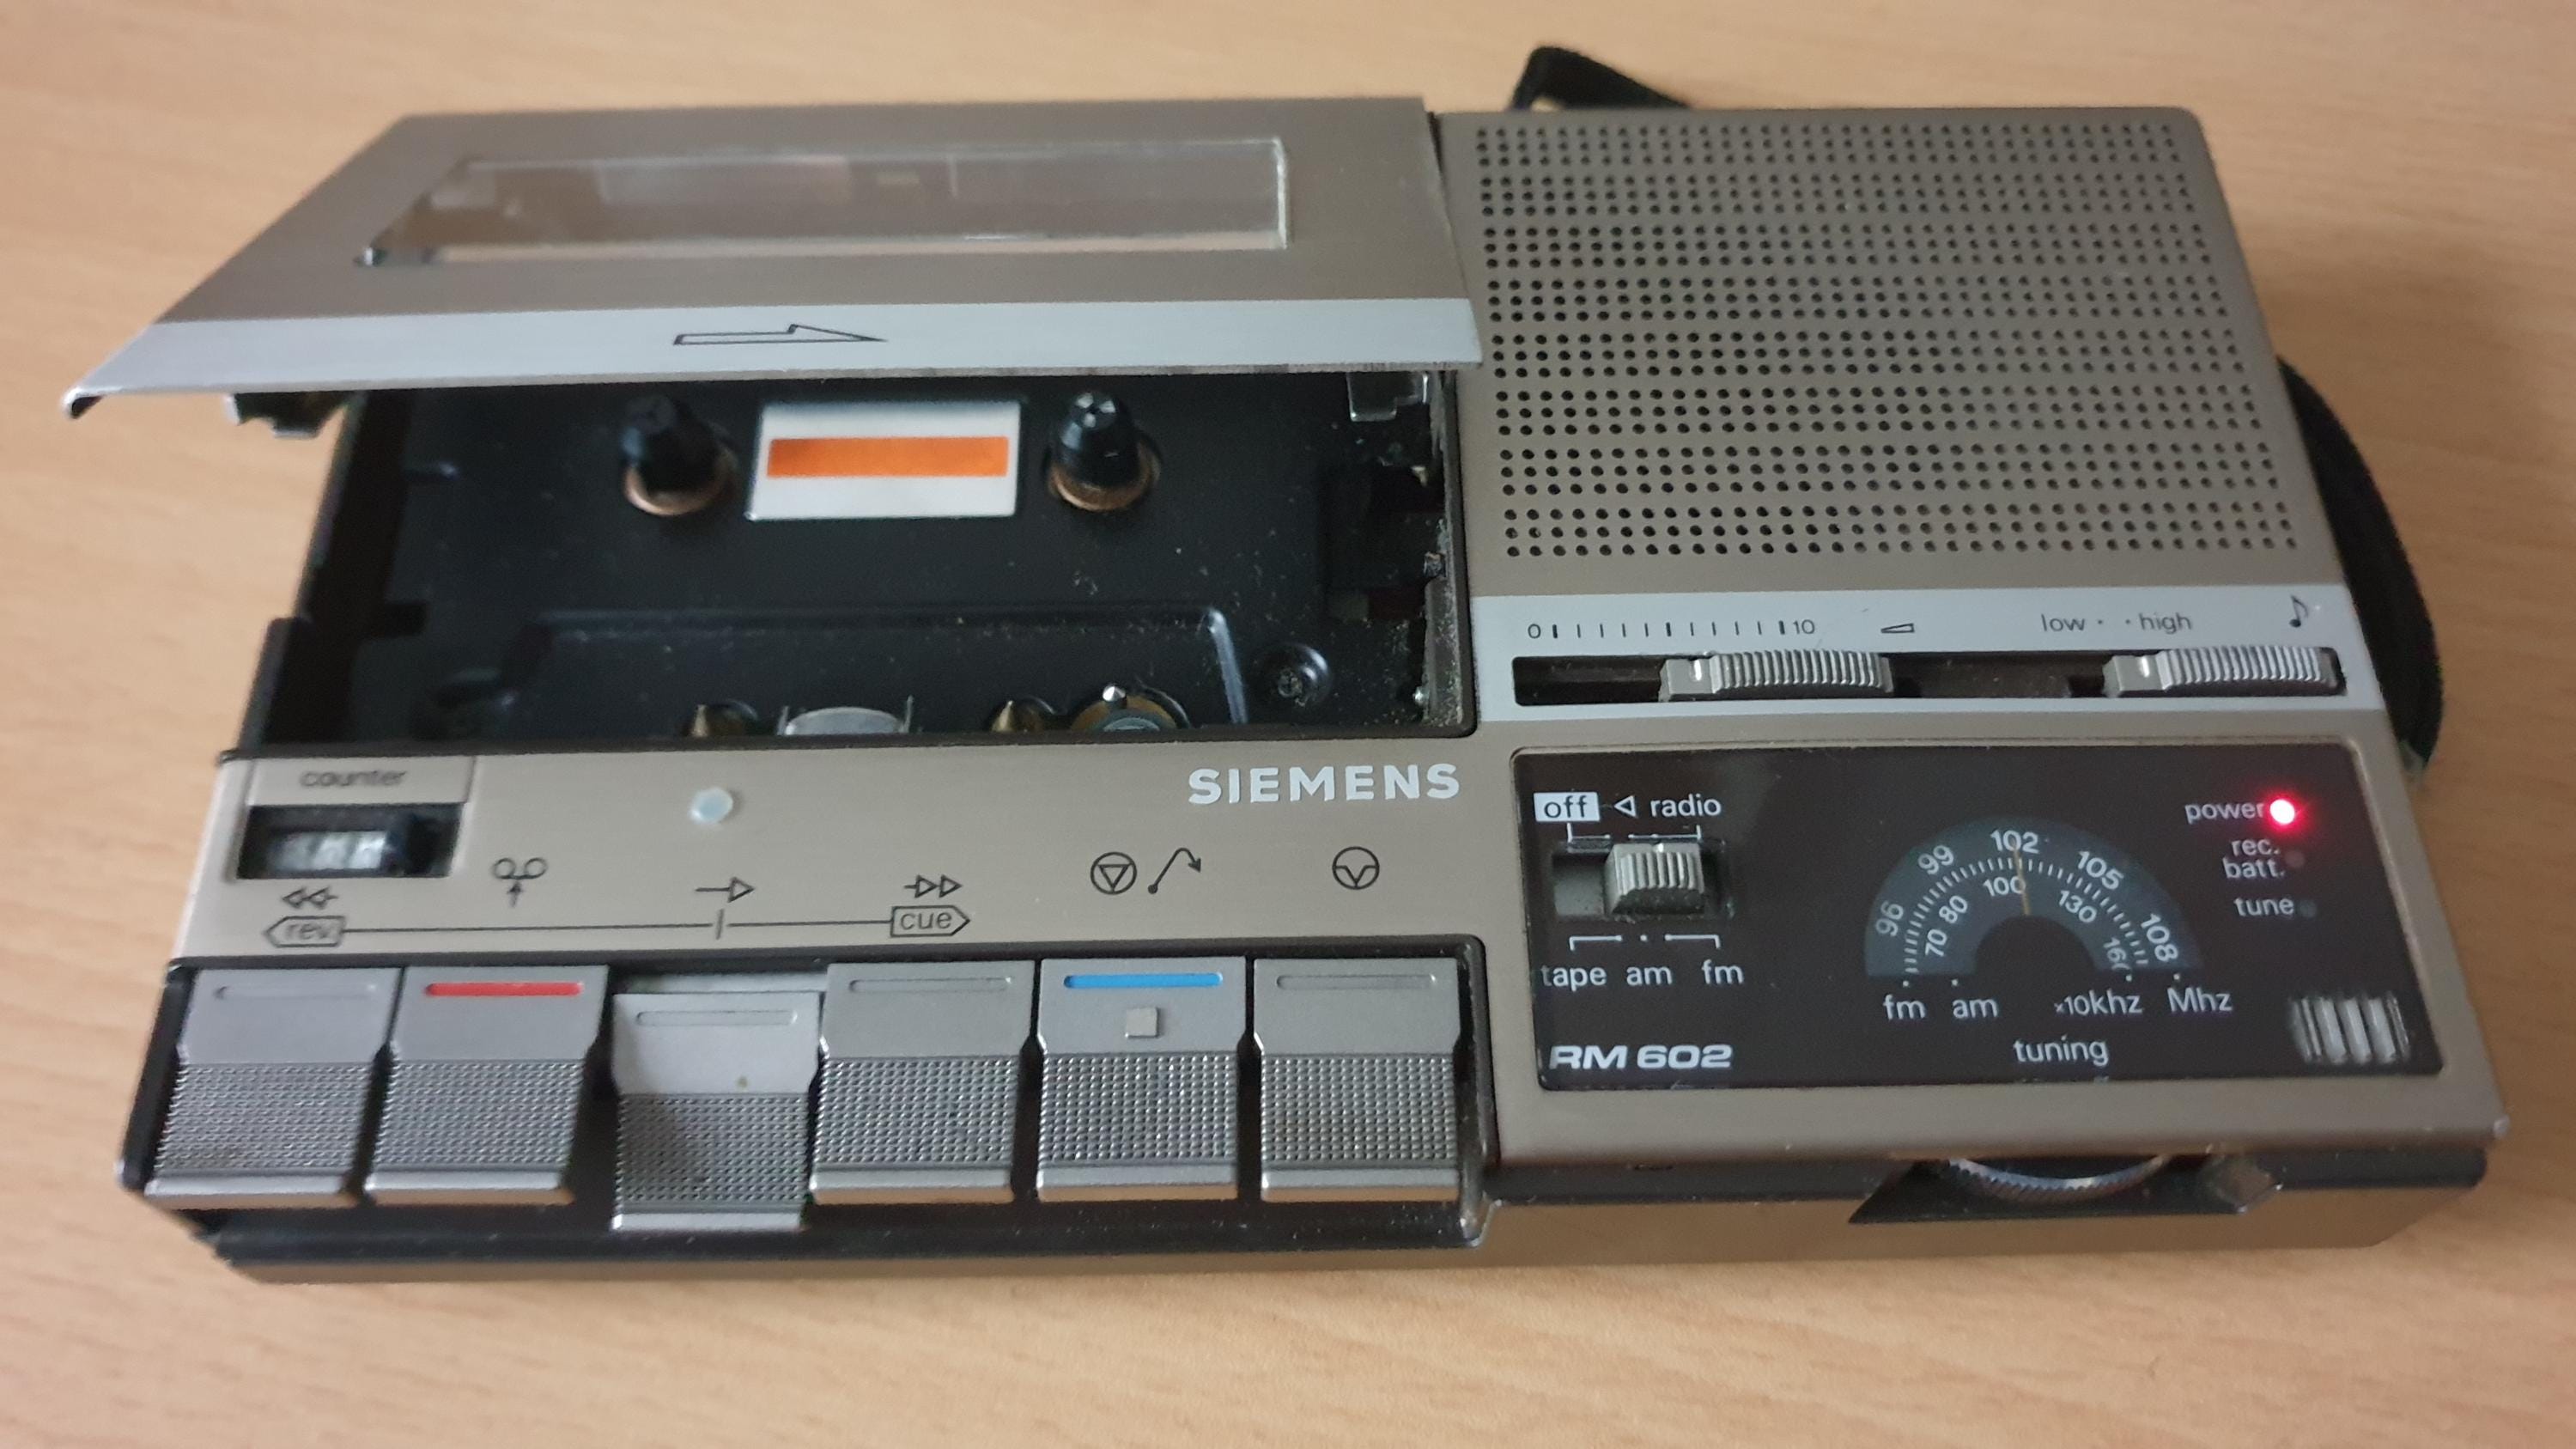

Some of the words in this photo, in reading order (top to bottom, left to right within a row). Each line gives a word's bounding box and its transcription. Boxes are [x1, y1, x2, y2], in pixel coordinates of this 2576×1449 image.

[1792, 618, 1816, 636] 10
[2041, 613, 2086, 632] low
[2139, 612, 2192, 635] high
[300, 769, 407, 788] counter
[1188, 764, 1461, 804] SIEMENS
[1544, 795, 1589, 819] off
[1650, 794, 1722, 817] radio
[2184, 801, 2265, 824] power
[2232, 837, 2281, 856] rec.
[2222, 857, 2286, 880] batt.
[1875, 900, 1905, 937] 96
[1917, 844, 1954, 874] 99
[1990, 829, 2040, 855] 102
[2076, 850, 2124, 891] 105
[2141, 912, 2179, 962] 108
[2234, 896, 2295, 917] tune
[899, 910, 953, 932] cue
[1924, 928, 1947, 957] 70
[1938, 895, 1969, 924] 80
[1983, 875, 2026, 897] 100
[2059, 890, 2098, 923] 130
[284, 919, 333, 941] rev
[1540, 965, 1607, 992] tape
[1626, 966, 1674, 985] am
[1702, 959, 1744, 984] fm
[1883, 995, 1927, 1020] fm
[1952, 997, 1999, 1019] am
[2166, 986, 2233, 1014] Mhz
[1549, 1044, 1629, 1069] RM
[1637, 1044, 1734, 1069] 602
[2013, 1035, 2110, 1068] tuning
